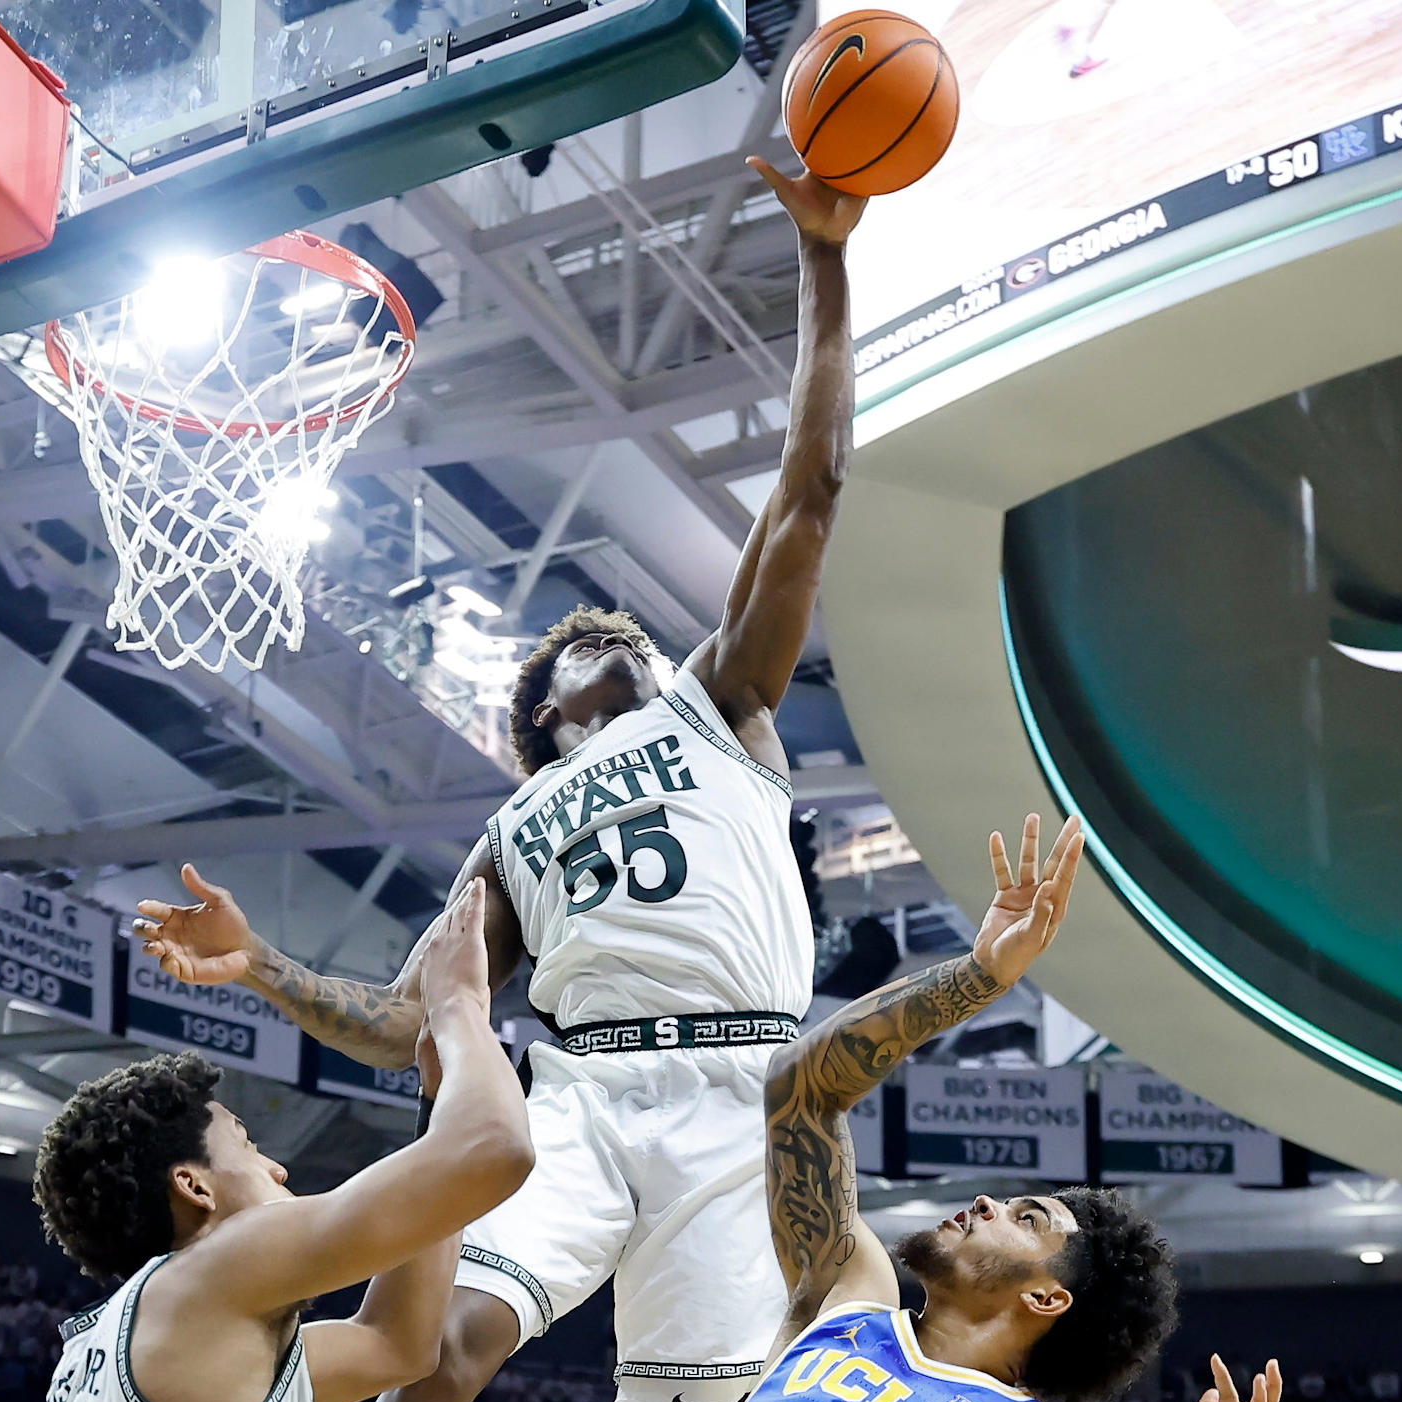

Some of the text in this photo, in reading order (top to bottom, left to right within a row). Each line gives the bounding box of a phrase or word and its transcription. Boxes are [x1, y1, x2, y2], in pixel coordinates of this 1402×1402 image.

[1048, 202, 1167, 275] GEORGIA
[1268, 140, 1319, 187] 50
[541, 748, 649, 820] MICHIGAN
[512, 734, 701, 885] STATE
[555, 804, 688, 918] 55
[180, 1014, 249, 1050] 1999
[654, 1017, 680, 1047] S
[374, 1067, 419, 1095] 199
[944, 1077, 1047, 1100] BIG TEN
[1137, 1083, 1183, 1105] BIG
[912, 1104, 1081, 1129] CHAMPIONS
[962, 1137, 1033, 1164] 1978
[1157, 1144, 1225, 1170] 1967
